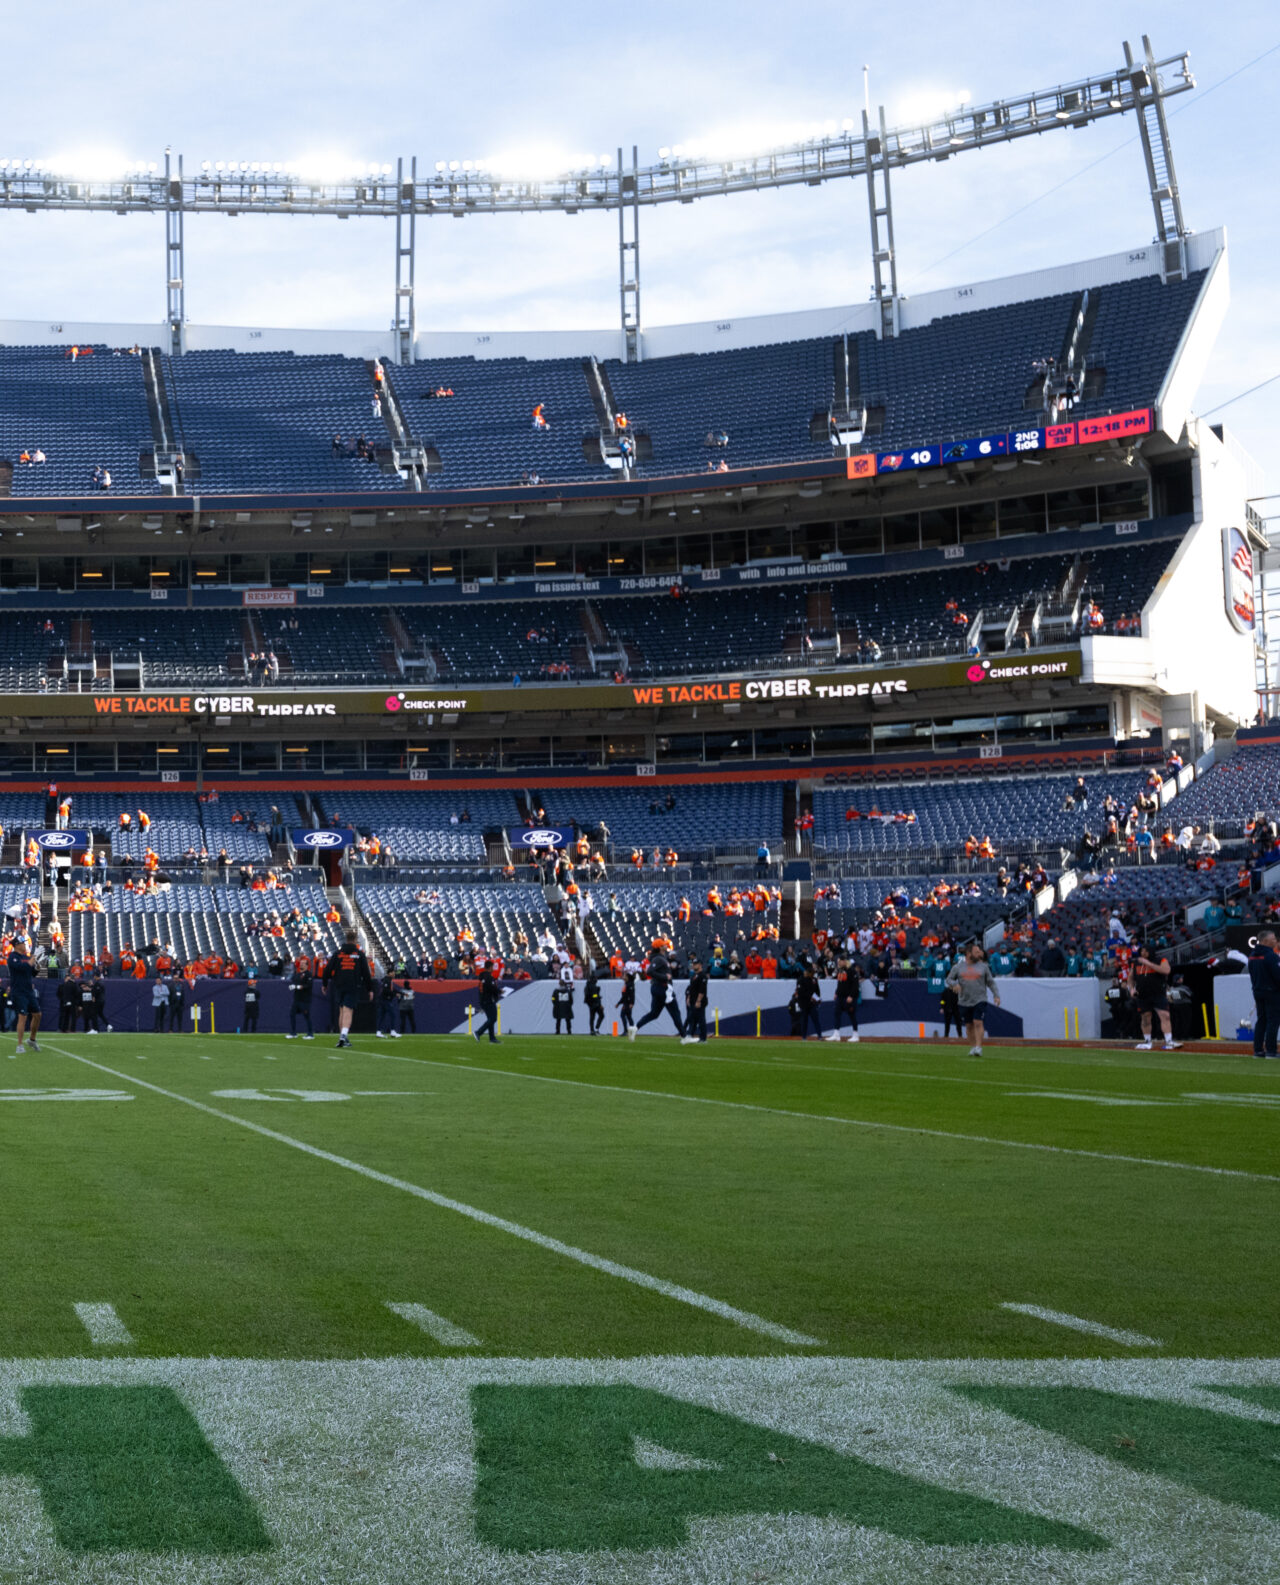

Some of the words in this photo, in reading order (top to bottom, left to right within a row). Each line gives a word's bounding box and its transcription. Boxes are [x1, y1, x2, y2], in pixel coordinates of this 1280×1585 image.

[1129, 252, 1146, 262] 542
[958, 288, 973, 298] 541
[1082, 421, 1120, 436] 12:18
[1124, 416, 1145, 428] PM
[1015, 430, 1039, 442] 2ND
[1048, 427, 1072, 437] CAR
[979, 441, 992, 454] 6
[910, 450, 932, 465] 10
[1117, 522, 1136, 533] 346
[739, 569, 760, 580] with
[767, 565, 786, 577] info
[787, 563, 806, 575] and
[807, 561, 848, 574] location
[535, 583, 551, 593] Fan
[552, 581, 581, 592] issues
[583, 581, 600, 591] text
[247, 591, 293, 601] RESPECT
[989, 666, 1029, 678] CHECK
[1031, 662, 1068, 674] POINT
[633, 687, 664, 704] WE
[668, 683, 742, 702] TACKLE
[745, 679, 812, 699] CYBER
[94, 697, 121, 713] WE
[125, 697, 190, 713] TACKLE
[194, 697, 254, 713] CYBER
[404, 700, 435, 710] CHECK
[437, 700, 467, 709] POINT
[412, 771, 427, 779] 127
[638, 766, 654, 775] 128
[163, 773, 178, 781] 126
